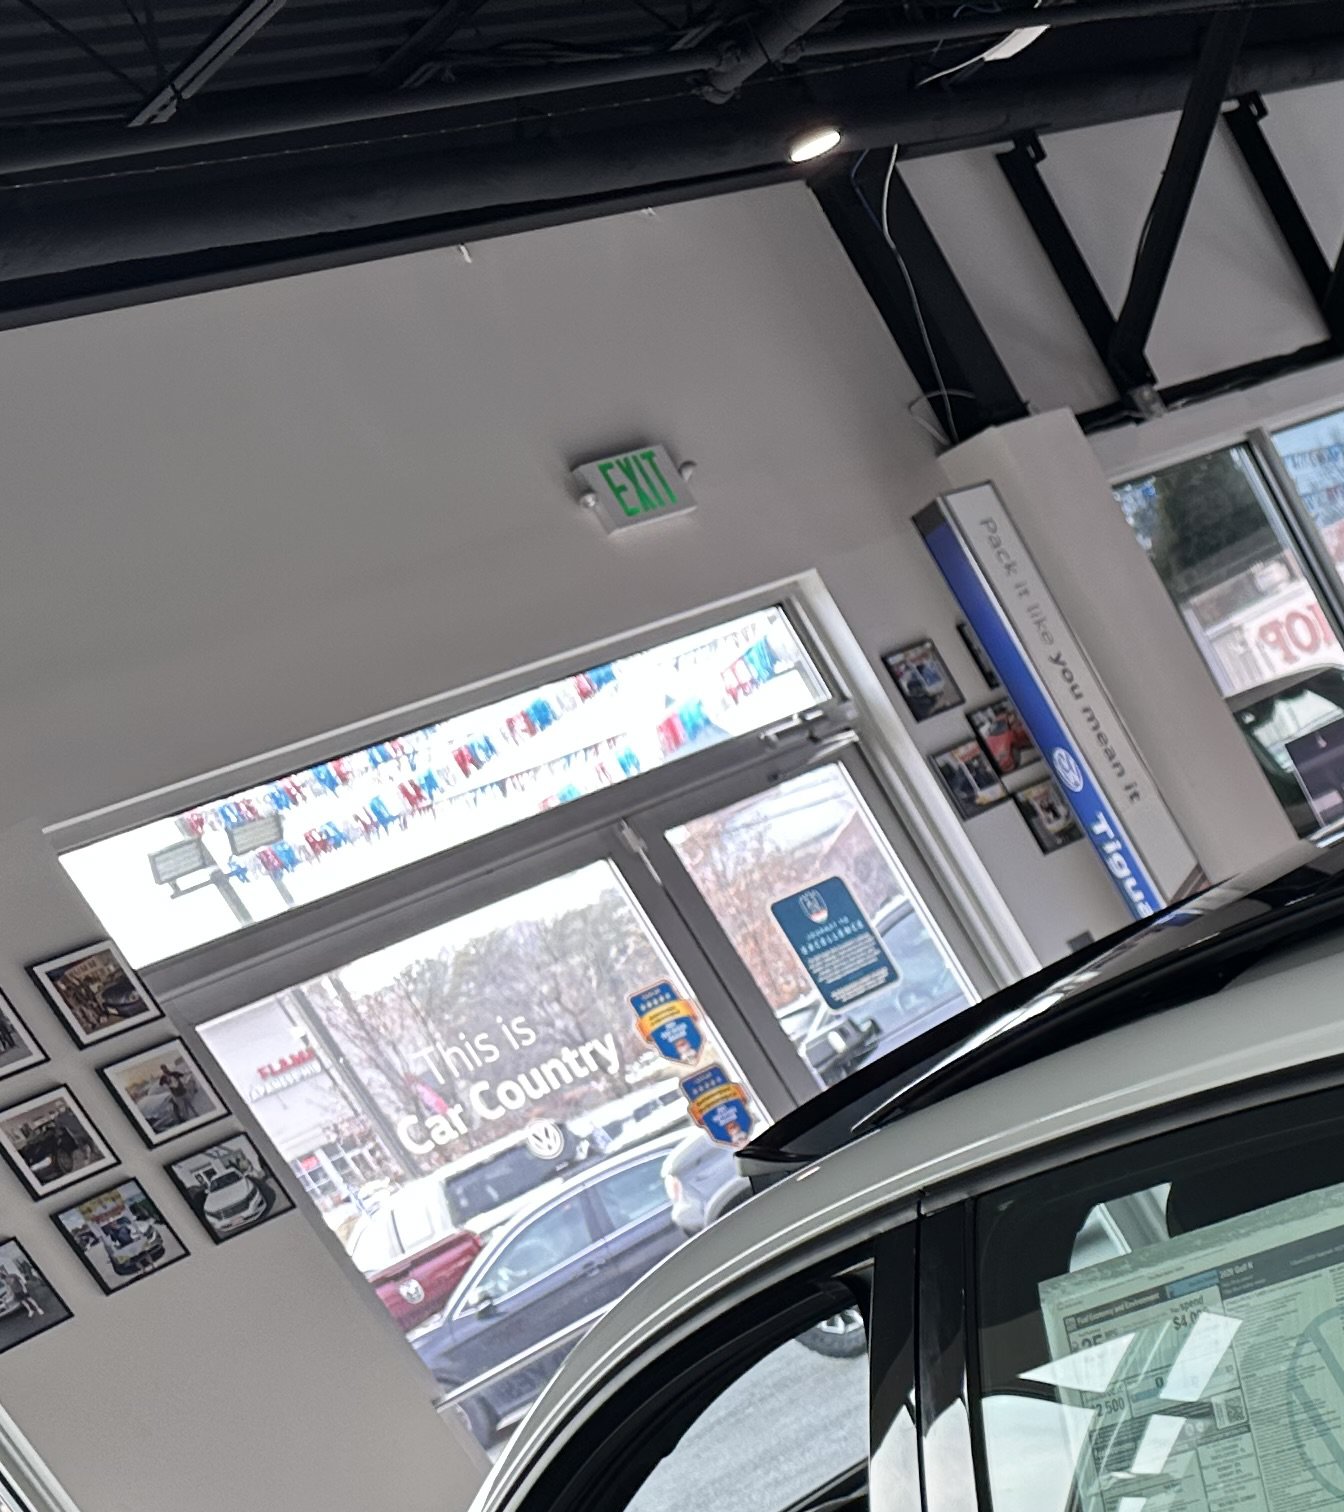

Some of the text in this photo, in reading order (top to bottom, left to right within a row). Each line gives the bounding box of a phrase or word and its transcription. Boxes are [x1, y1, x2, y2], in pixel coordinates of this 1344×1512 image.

[597, 449, 678, 517] EXIT
[979, 516, 1141, 803] Pack it like you mean it
[1092, 811, 1154, 919] Tigua
[397, 1103, 468, 1155] Car
[469, 1032, 620, 1120] Country
[406, 1015, 536, 1085] This is
